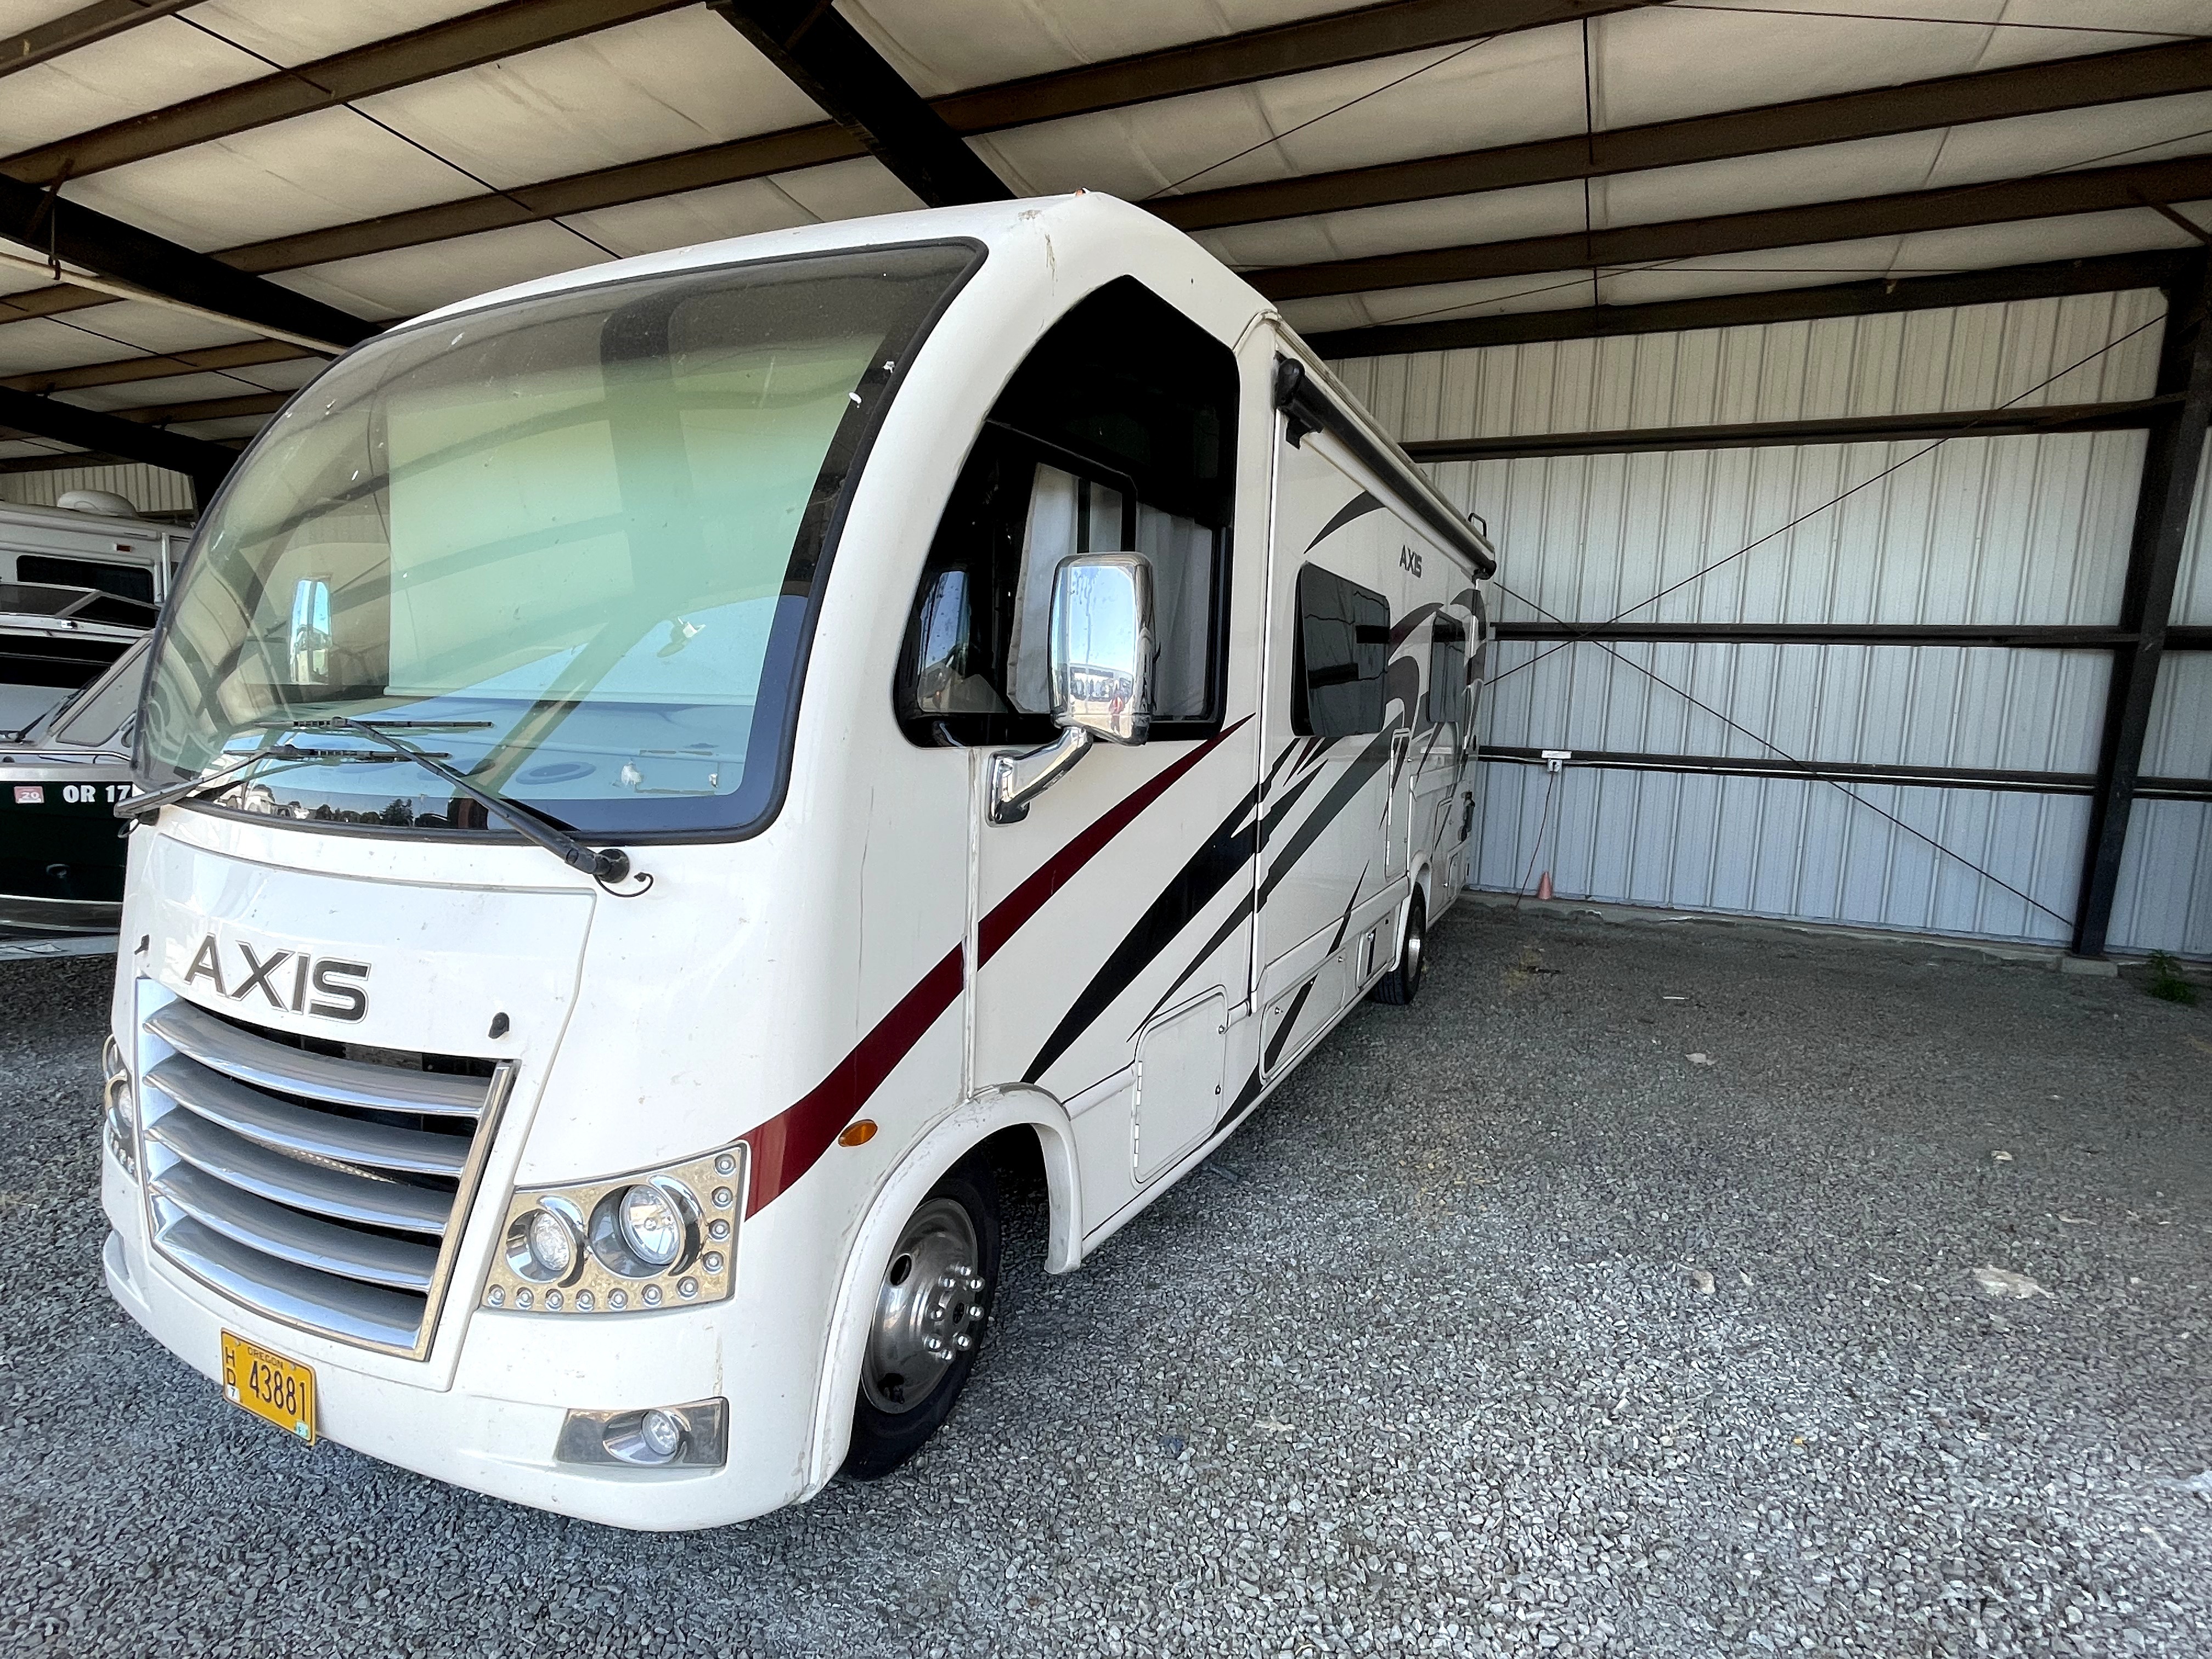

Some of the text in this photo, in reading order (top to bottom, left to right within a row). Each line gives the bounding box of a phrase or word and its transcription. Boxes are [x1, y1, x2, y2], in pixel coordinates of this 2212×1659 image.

[1399, 544, 1422, 578] AXIS
[63, 785, 95, 804] OR
[184, 933, 372, 1025] AXIS
[247, 1346, 283, 1370] OREGON
[230, 1387, 236, 1397] 7
[250, 1360, 305, 1422] 43881
